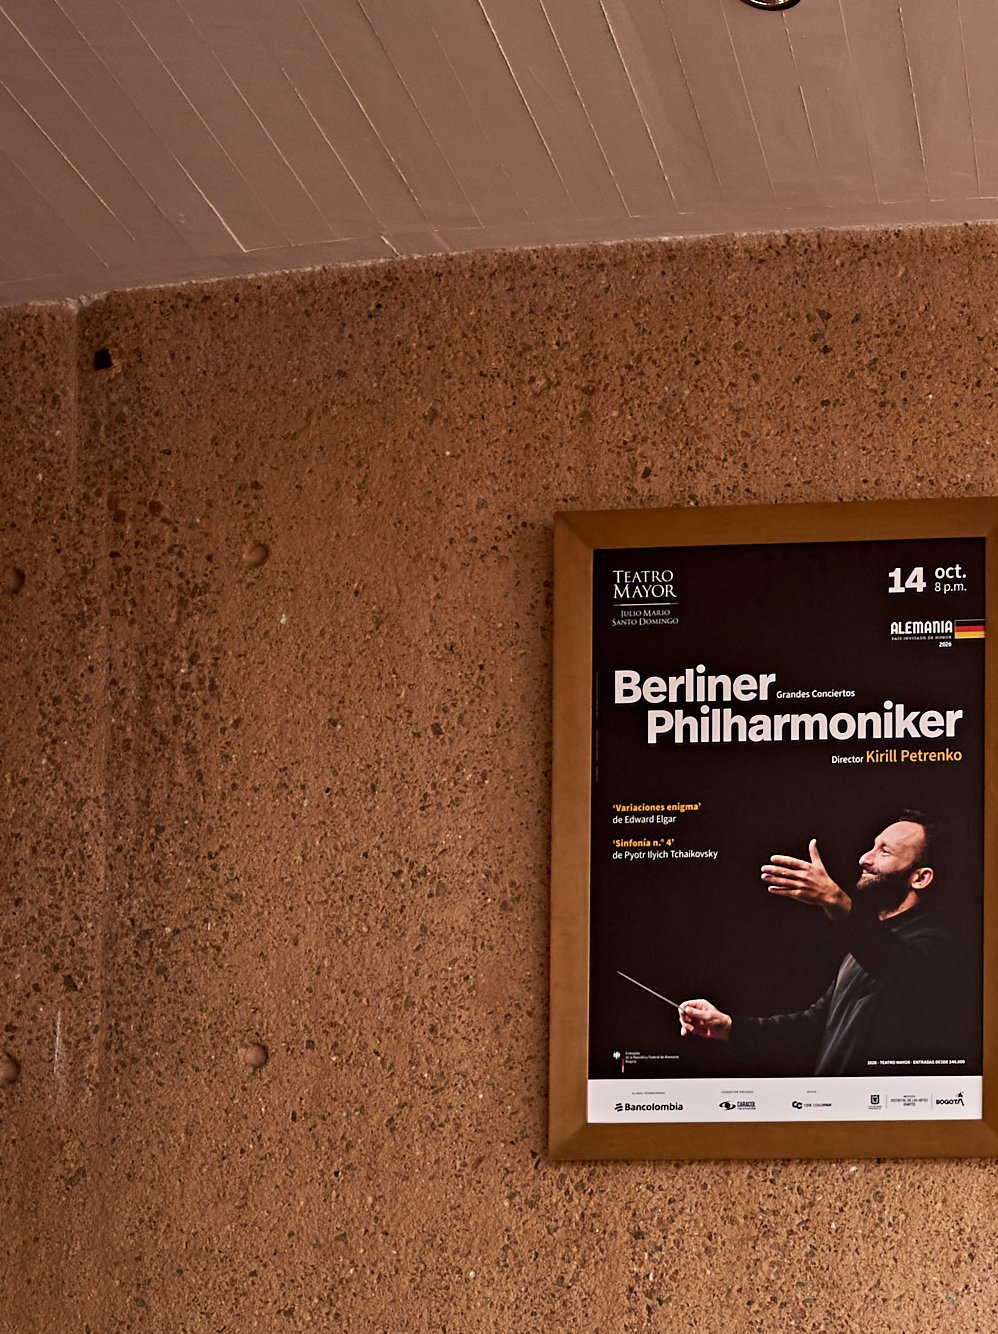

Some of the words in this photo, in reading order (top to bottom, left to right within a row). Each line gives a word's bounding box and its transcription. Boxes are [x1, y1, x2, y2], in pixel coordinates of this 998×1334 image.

[612, 570, 674, 583] TEATRO
[935, 564, 967, 579] oct.
[888, 567, 927, 593] 14
[614, 584, 677, 598] MAYOR
[934, 582, 941, 592] 8
[943, 583, 967, 594] p.m.
[890, 620, 953, 635] ALEMANIA
[614, 664, 776, 704] Berliner
[776, 690, 810, 699] Grandes
[812, 689, 856, 698] Conciertos
[647, 700, 963, 744] Philharmoniker
[831, 754, 864, 764] Director
[866, 749, 897, 763] Kirill
[901, 748, 962, 763] Petrenko
[612, 815, 623, 824] de
[624, 815, 655, 824] Edward
[656, 815, 676, 825] Elgar
[612, 851, 623, 859] de
[624, 851, 646, 861] Pyotr
[648, 850, 668, 860] Ilyich
[670, 849, 718, 859] Tchaikovsky
[625, 1102, 684, 1111] Bancolombia
